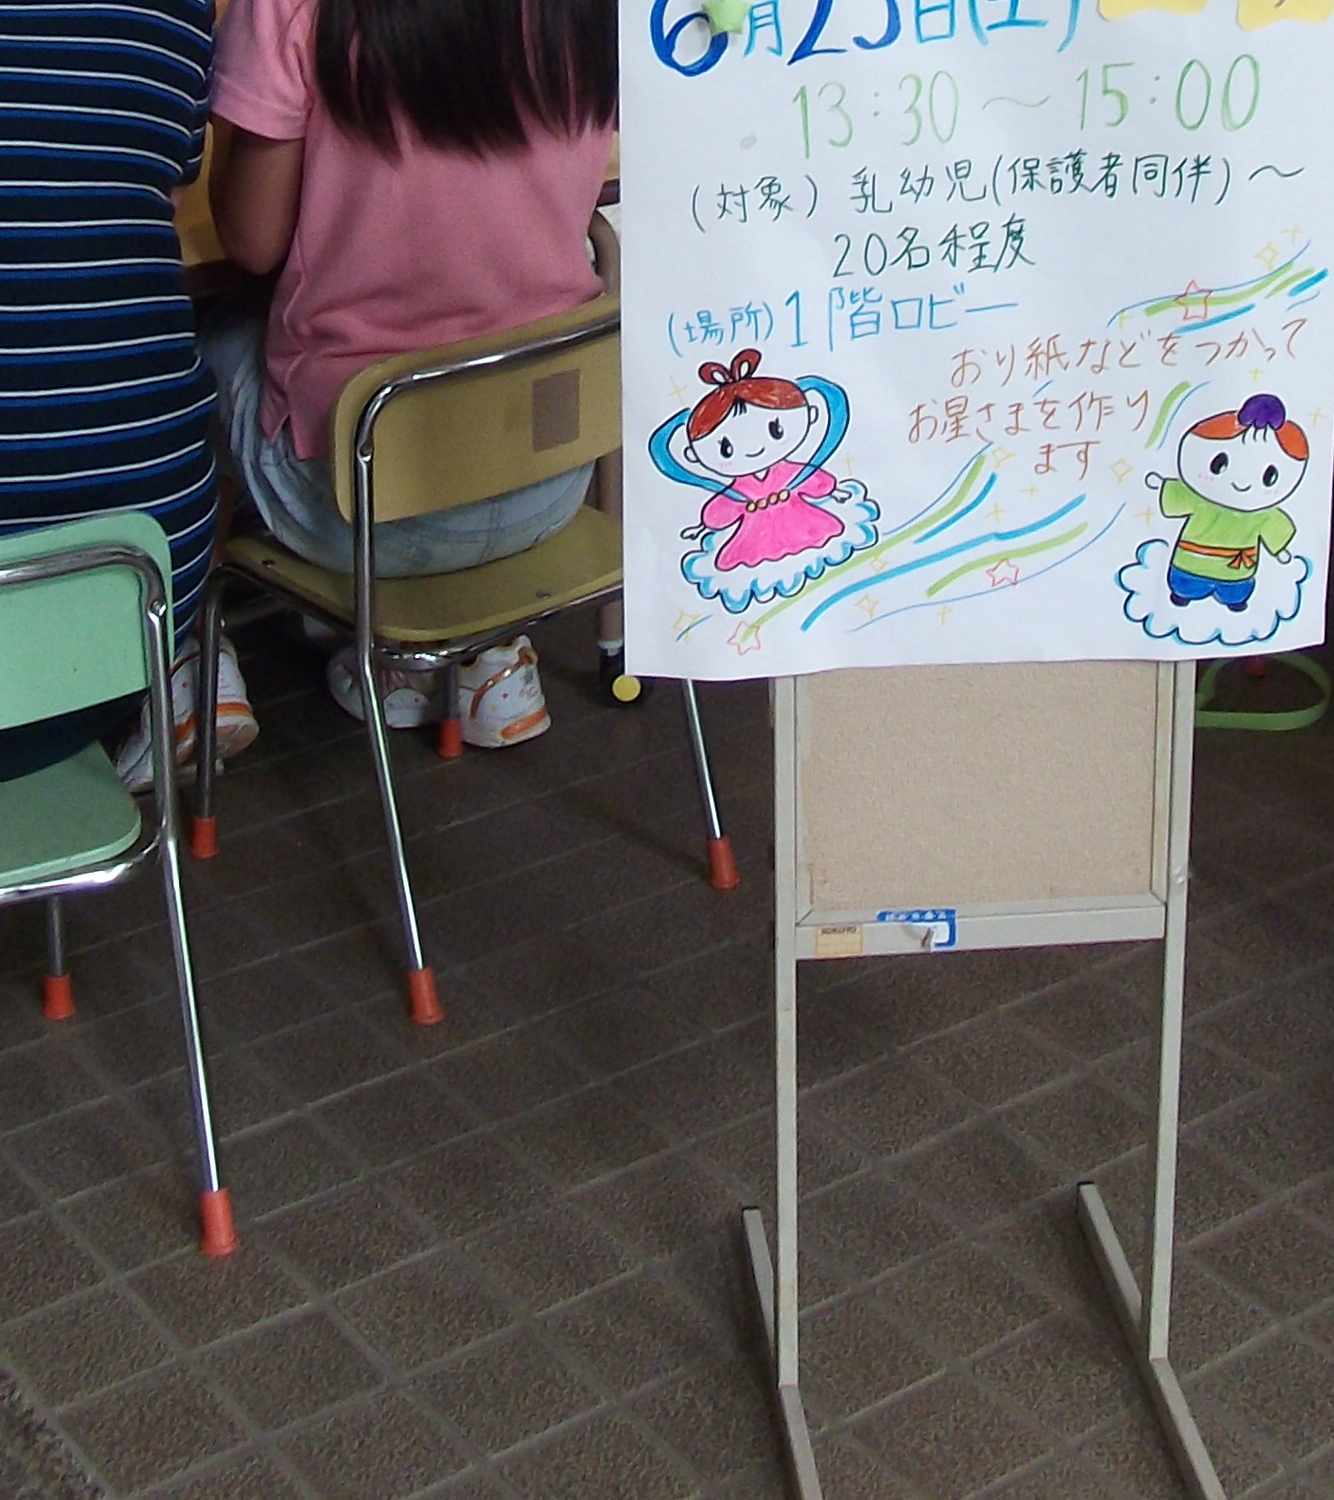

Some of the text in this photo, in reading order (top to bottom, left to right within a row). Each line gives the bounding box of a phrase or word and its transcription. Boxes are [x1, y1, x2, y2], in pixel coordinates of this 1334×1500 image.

[833, 212, 1037, 279] 20名程度
[950, 318, 1310, 388] おり紙などをつかって
[907, 389, 1151, 447] お星さまを作り
[1033, 439, 1100, 481] ます
